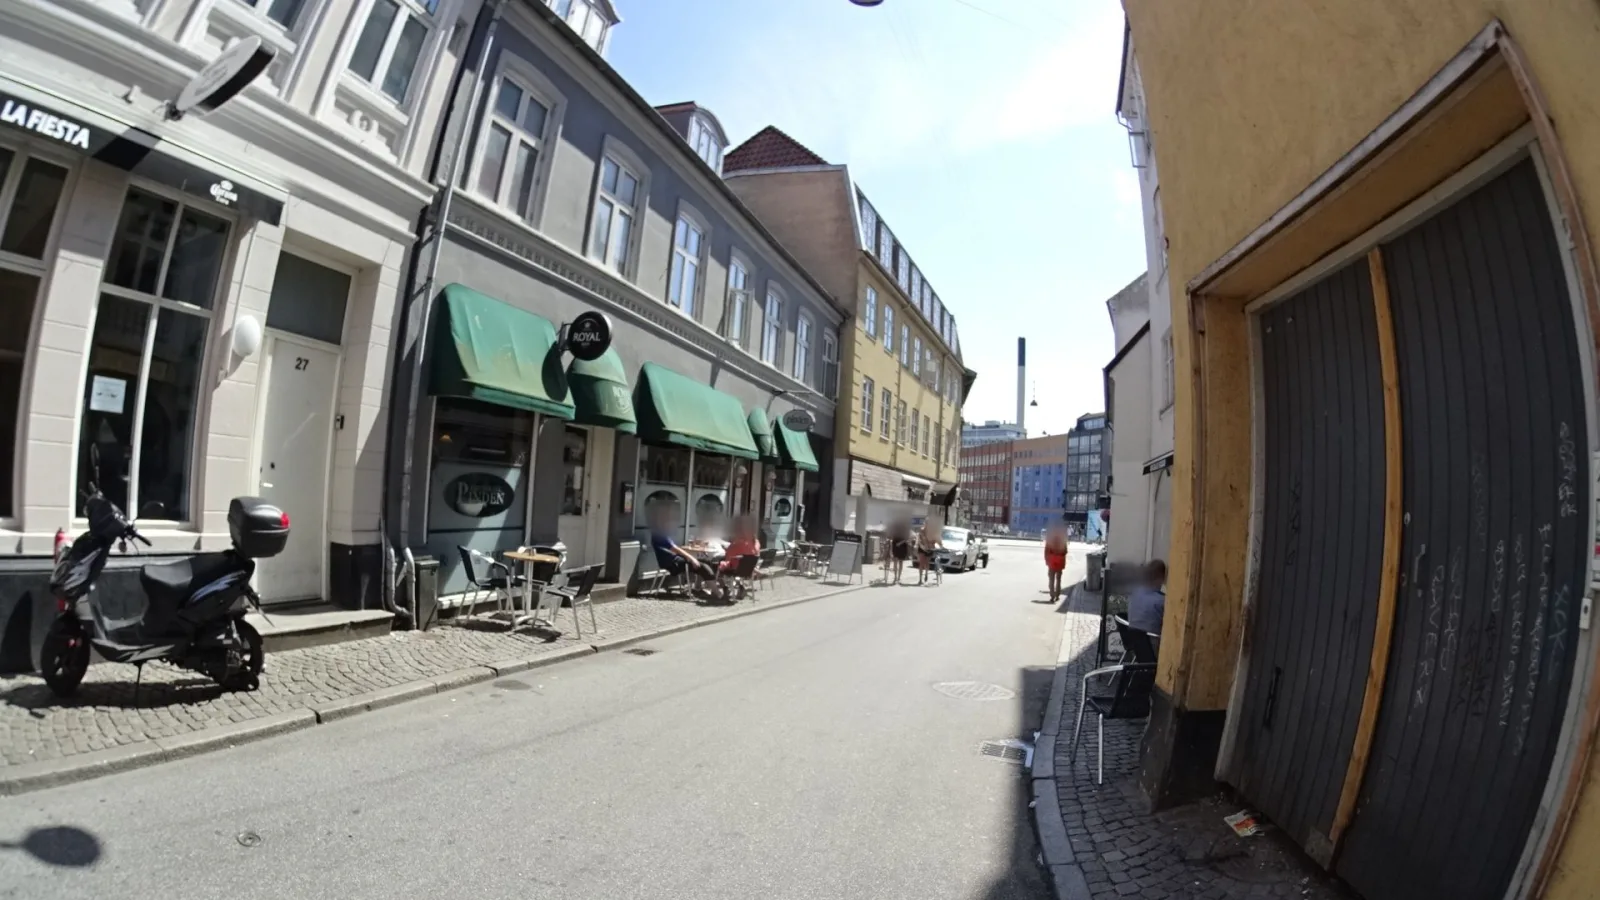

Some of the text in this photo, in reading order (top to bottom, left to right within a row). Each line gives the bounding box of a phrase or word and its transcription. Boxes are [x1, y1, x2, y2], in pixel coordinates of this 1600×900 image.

[0, 100, 90, 149] LA FIESTA
[572, 331, 601, 342] ROYAL
[295, 356, 309, 371] 27
